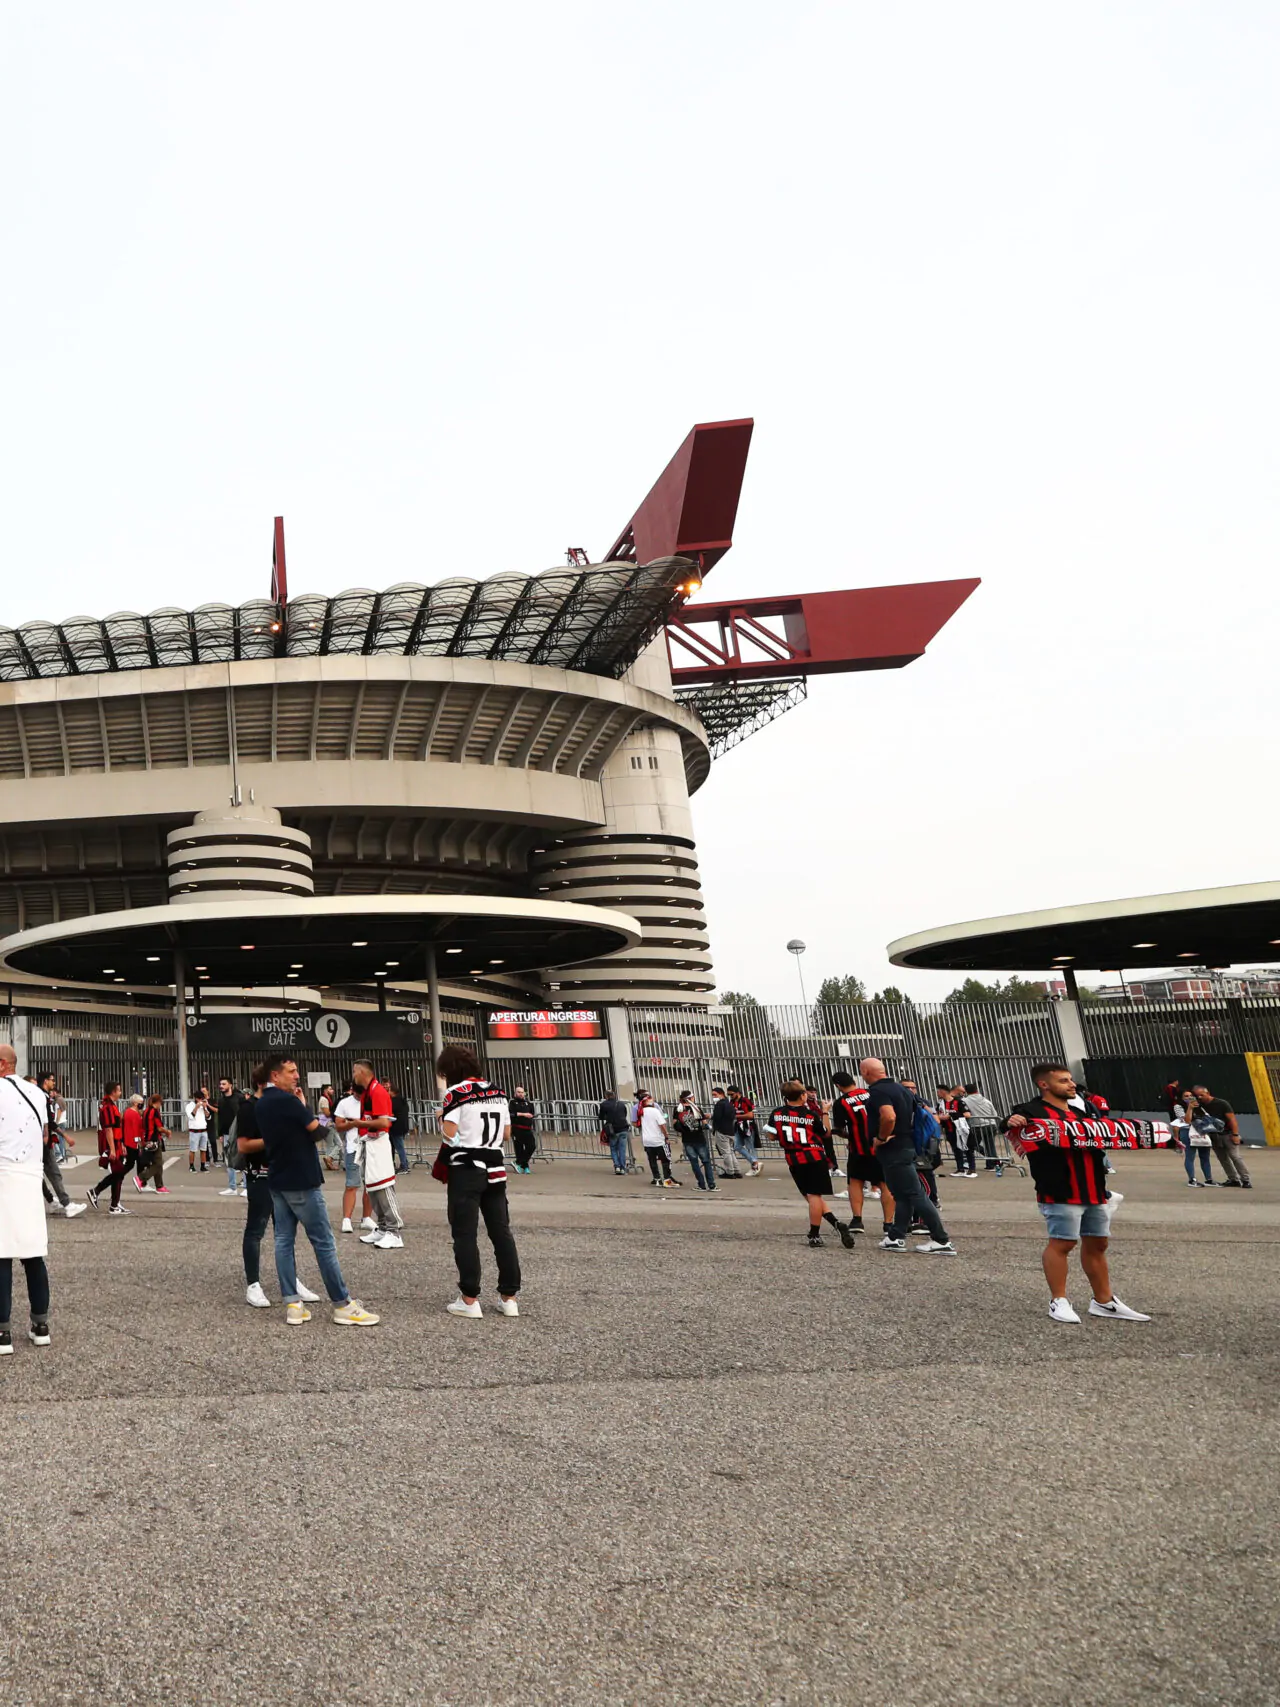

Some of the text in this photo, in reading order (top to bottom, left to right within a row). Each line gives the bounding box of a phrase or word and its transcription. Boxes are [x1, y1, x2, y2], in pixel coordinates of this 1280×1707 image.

[490, 1011, 596, 1021] APERTURA INGRESSI
[252, 1017, 339, 1044] INGRESSO 9
[269, 1032, 296, 1046] GATE
[782, 1125, 807, 1144] 11
[1064, 1121, 1085, 1138] AC
[1086, 1121, 1136, 1138] MILAN
[1073, 1139, 1099, 1147] Stadio
[1117, 1140, 1132, 1148] Siro
